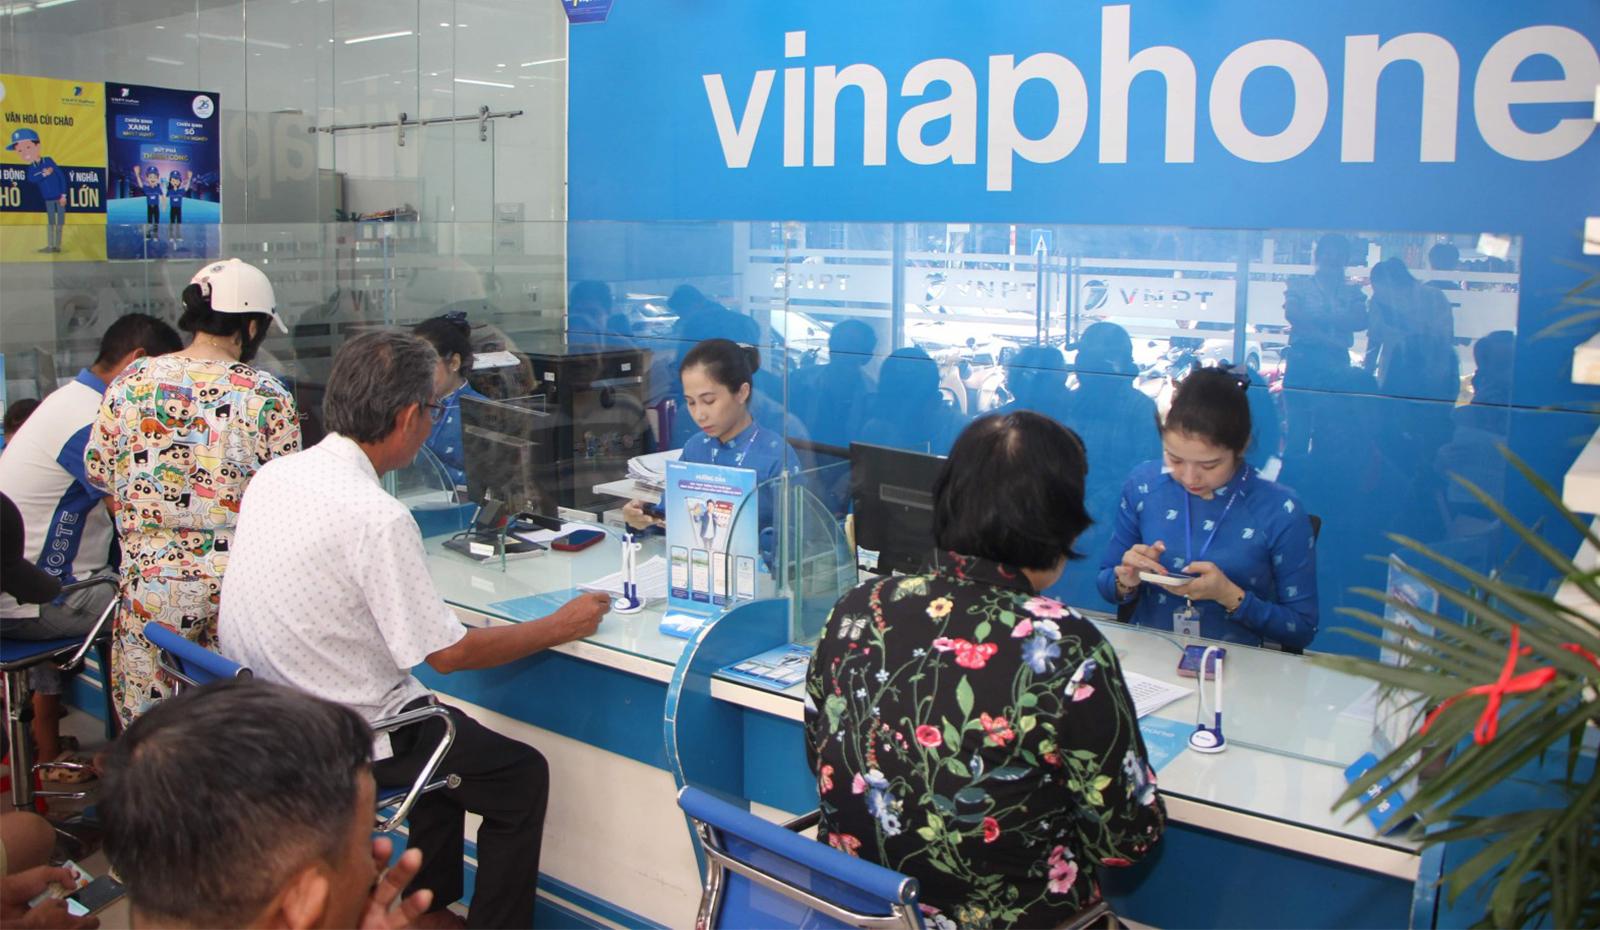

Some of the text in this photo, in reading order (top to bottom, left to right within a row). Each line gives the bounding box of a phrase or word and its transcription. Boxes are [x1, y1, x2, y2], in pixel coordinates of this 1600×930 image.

[702, 4, 1600, 192] vinaphone
[5, 111, 21, 123] VĂN
[128, 123, 150, 132] XANH
[3, 167, 26, 181] ĐỘNG
[69, 170, 99, 183] Ý NGHĨA
[70, 184, 99, 208] LỚN
[1120, 287, 1214, 311] VNPT
[44, 511, 79, 576] COSTE
